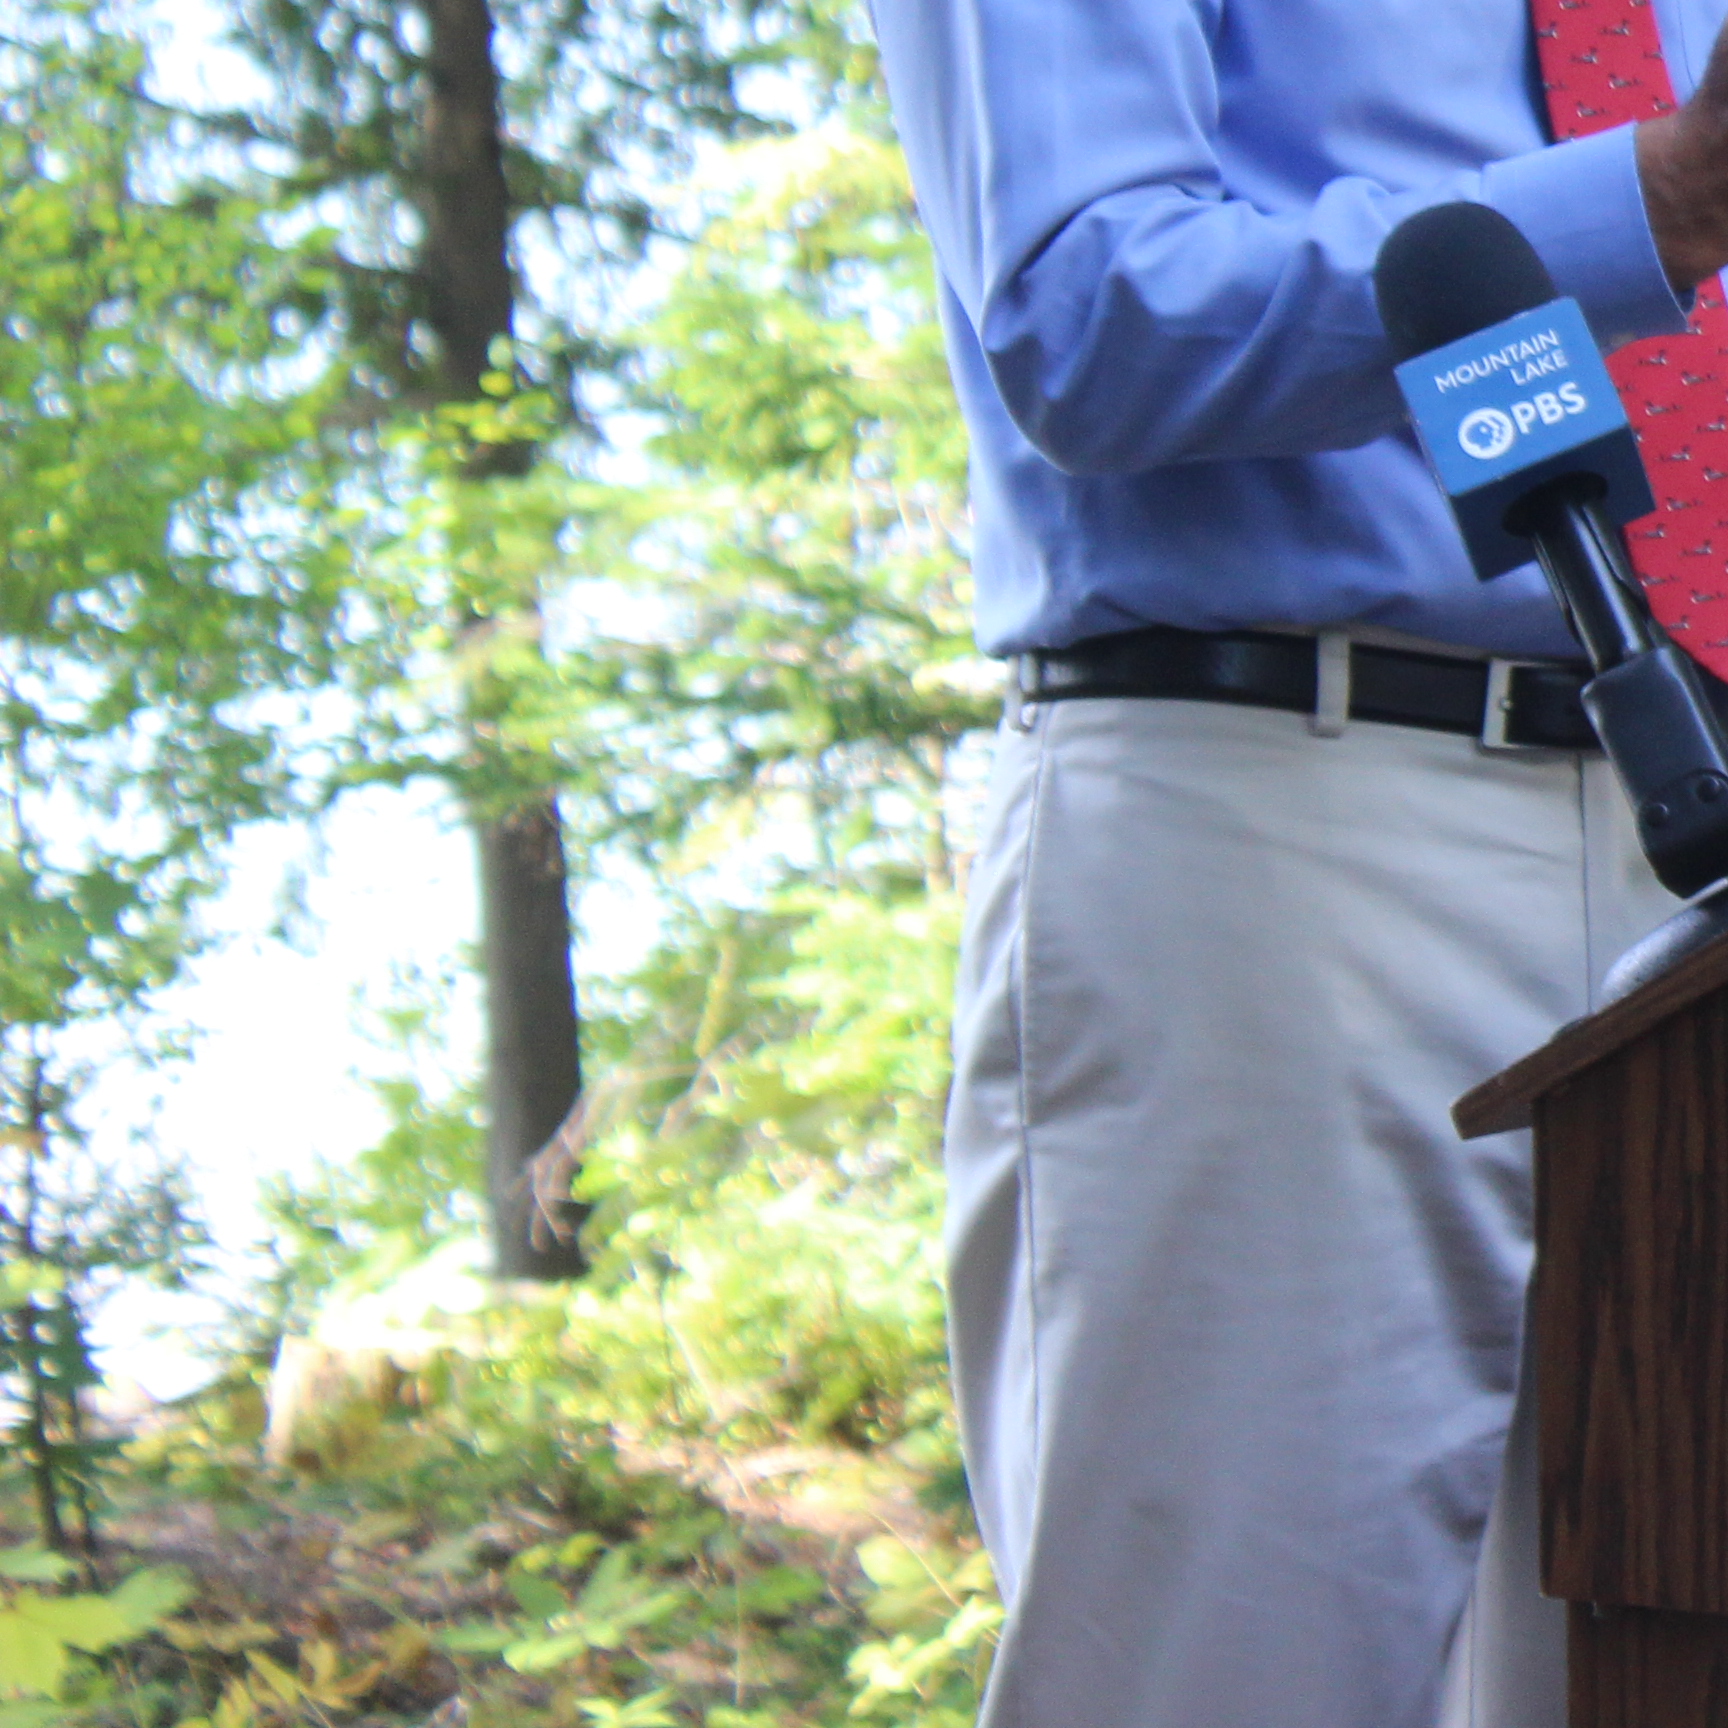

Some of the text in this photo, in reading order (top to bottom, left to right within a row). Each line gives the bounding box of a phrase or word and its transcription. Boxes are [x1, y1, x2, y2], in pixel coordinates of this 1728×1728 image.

[1433, 328, 1560, 394] MOUNTAIN
[1509, 349, 1569, 386] LAKE
[1510, 381, 1587, 435] PBS
